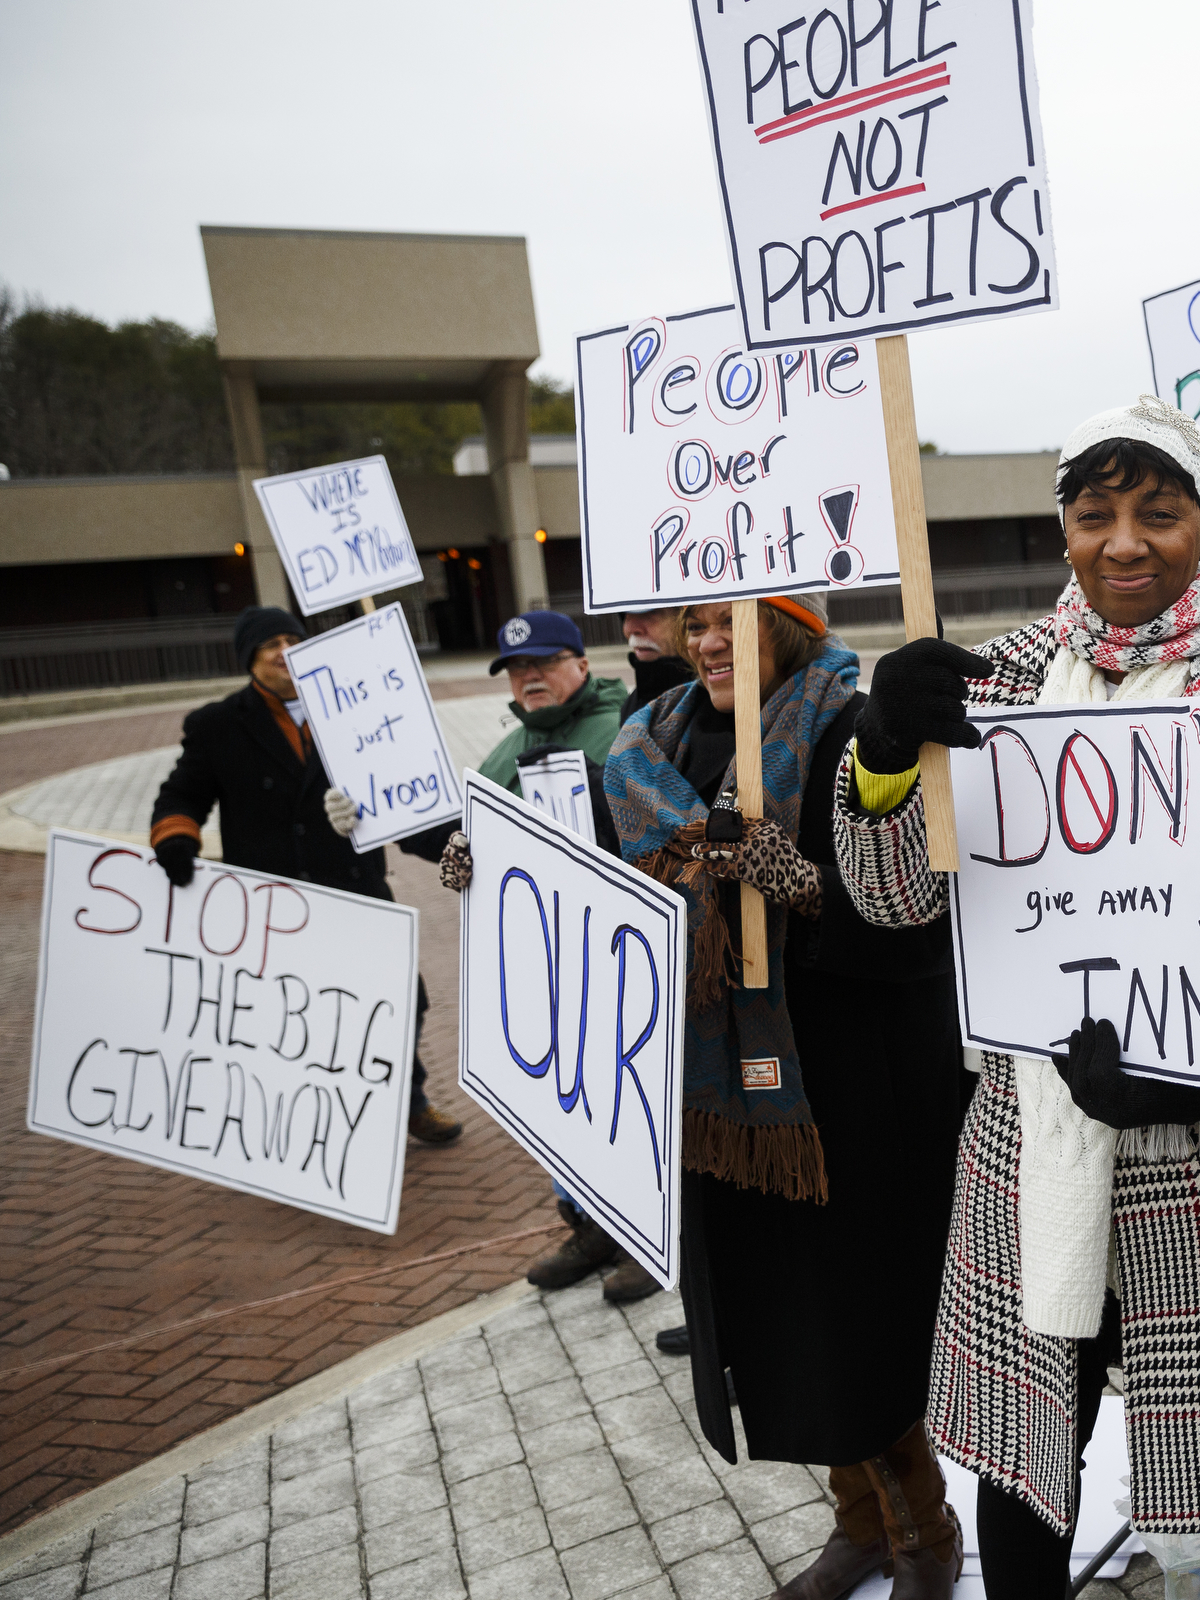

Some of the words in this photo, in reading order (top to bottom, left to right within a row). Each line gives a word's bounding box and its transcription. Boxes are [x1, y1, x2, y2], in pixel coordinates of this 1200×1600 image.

[744, 0, 957, 125] PEOPLE
[821, 95, 949, 206] NOT
[622, 316, 867, 434] People
[331, 503, 362, 534] IS
[666, 434, 787, 502] Over
[297, 545, 339, 593] ED
[298, 664, 370, 720] This
[379, 665, 404, 691] is
[354, 714, 404, 753] just
[75, 849, 310, 977] STOP
[1015, 886, 1077, 933] give
[1098, 884, 1173, 918] AWAY
[269, 974, 394, 1086] BIG
[498, 867, 663, 1193] OUR
[67, 1038, 373, 1200] GIVEAWAY
